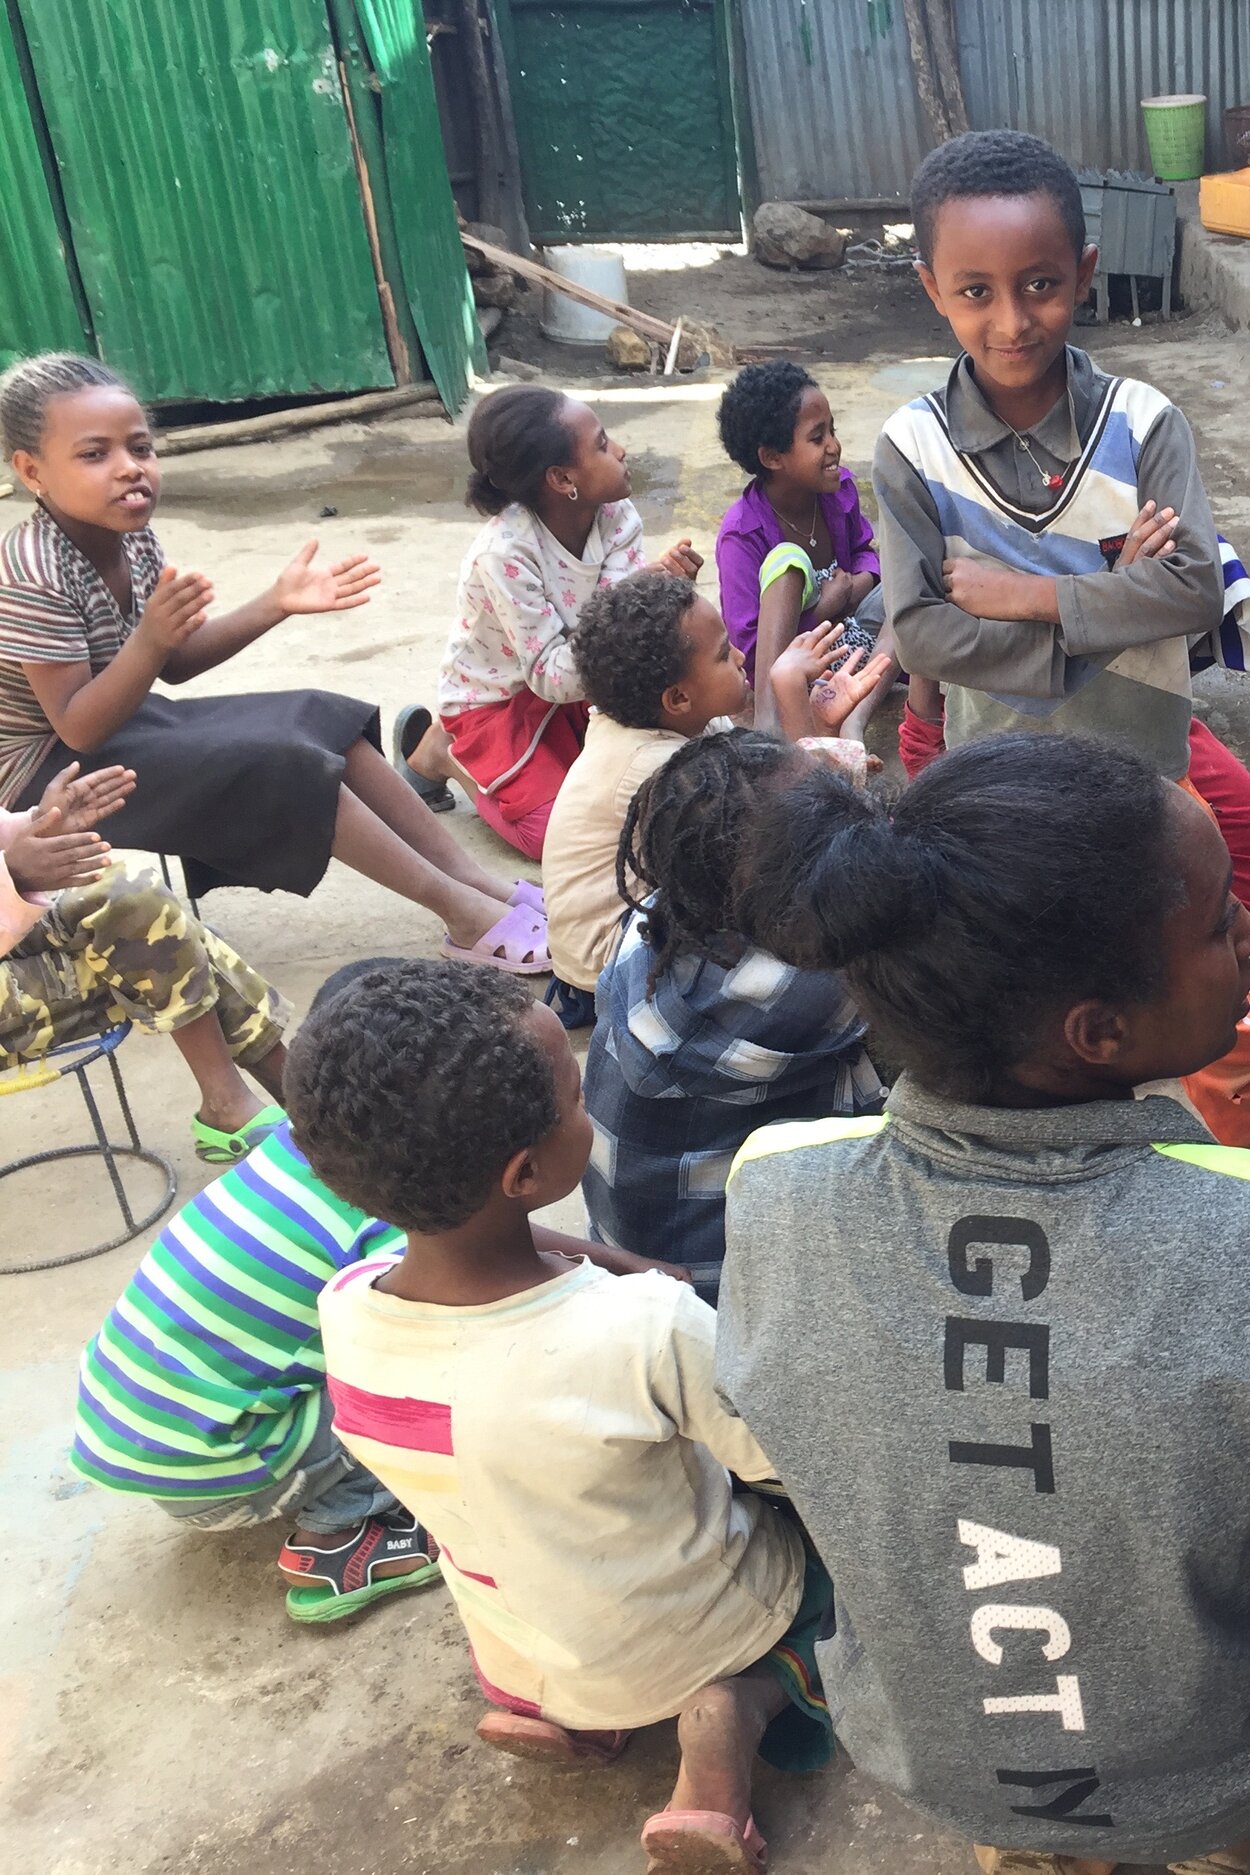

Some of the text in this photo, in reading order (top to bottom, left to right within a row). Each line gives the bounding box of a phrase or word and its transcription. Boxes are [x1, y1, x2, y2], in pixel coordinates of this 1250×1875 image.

[944, 1214, 1055, 1494] GET
[386, 1537, 413, 1550] BABY
[958, 1518, 1085, 1731] ACT
